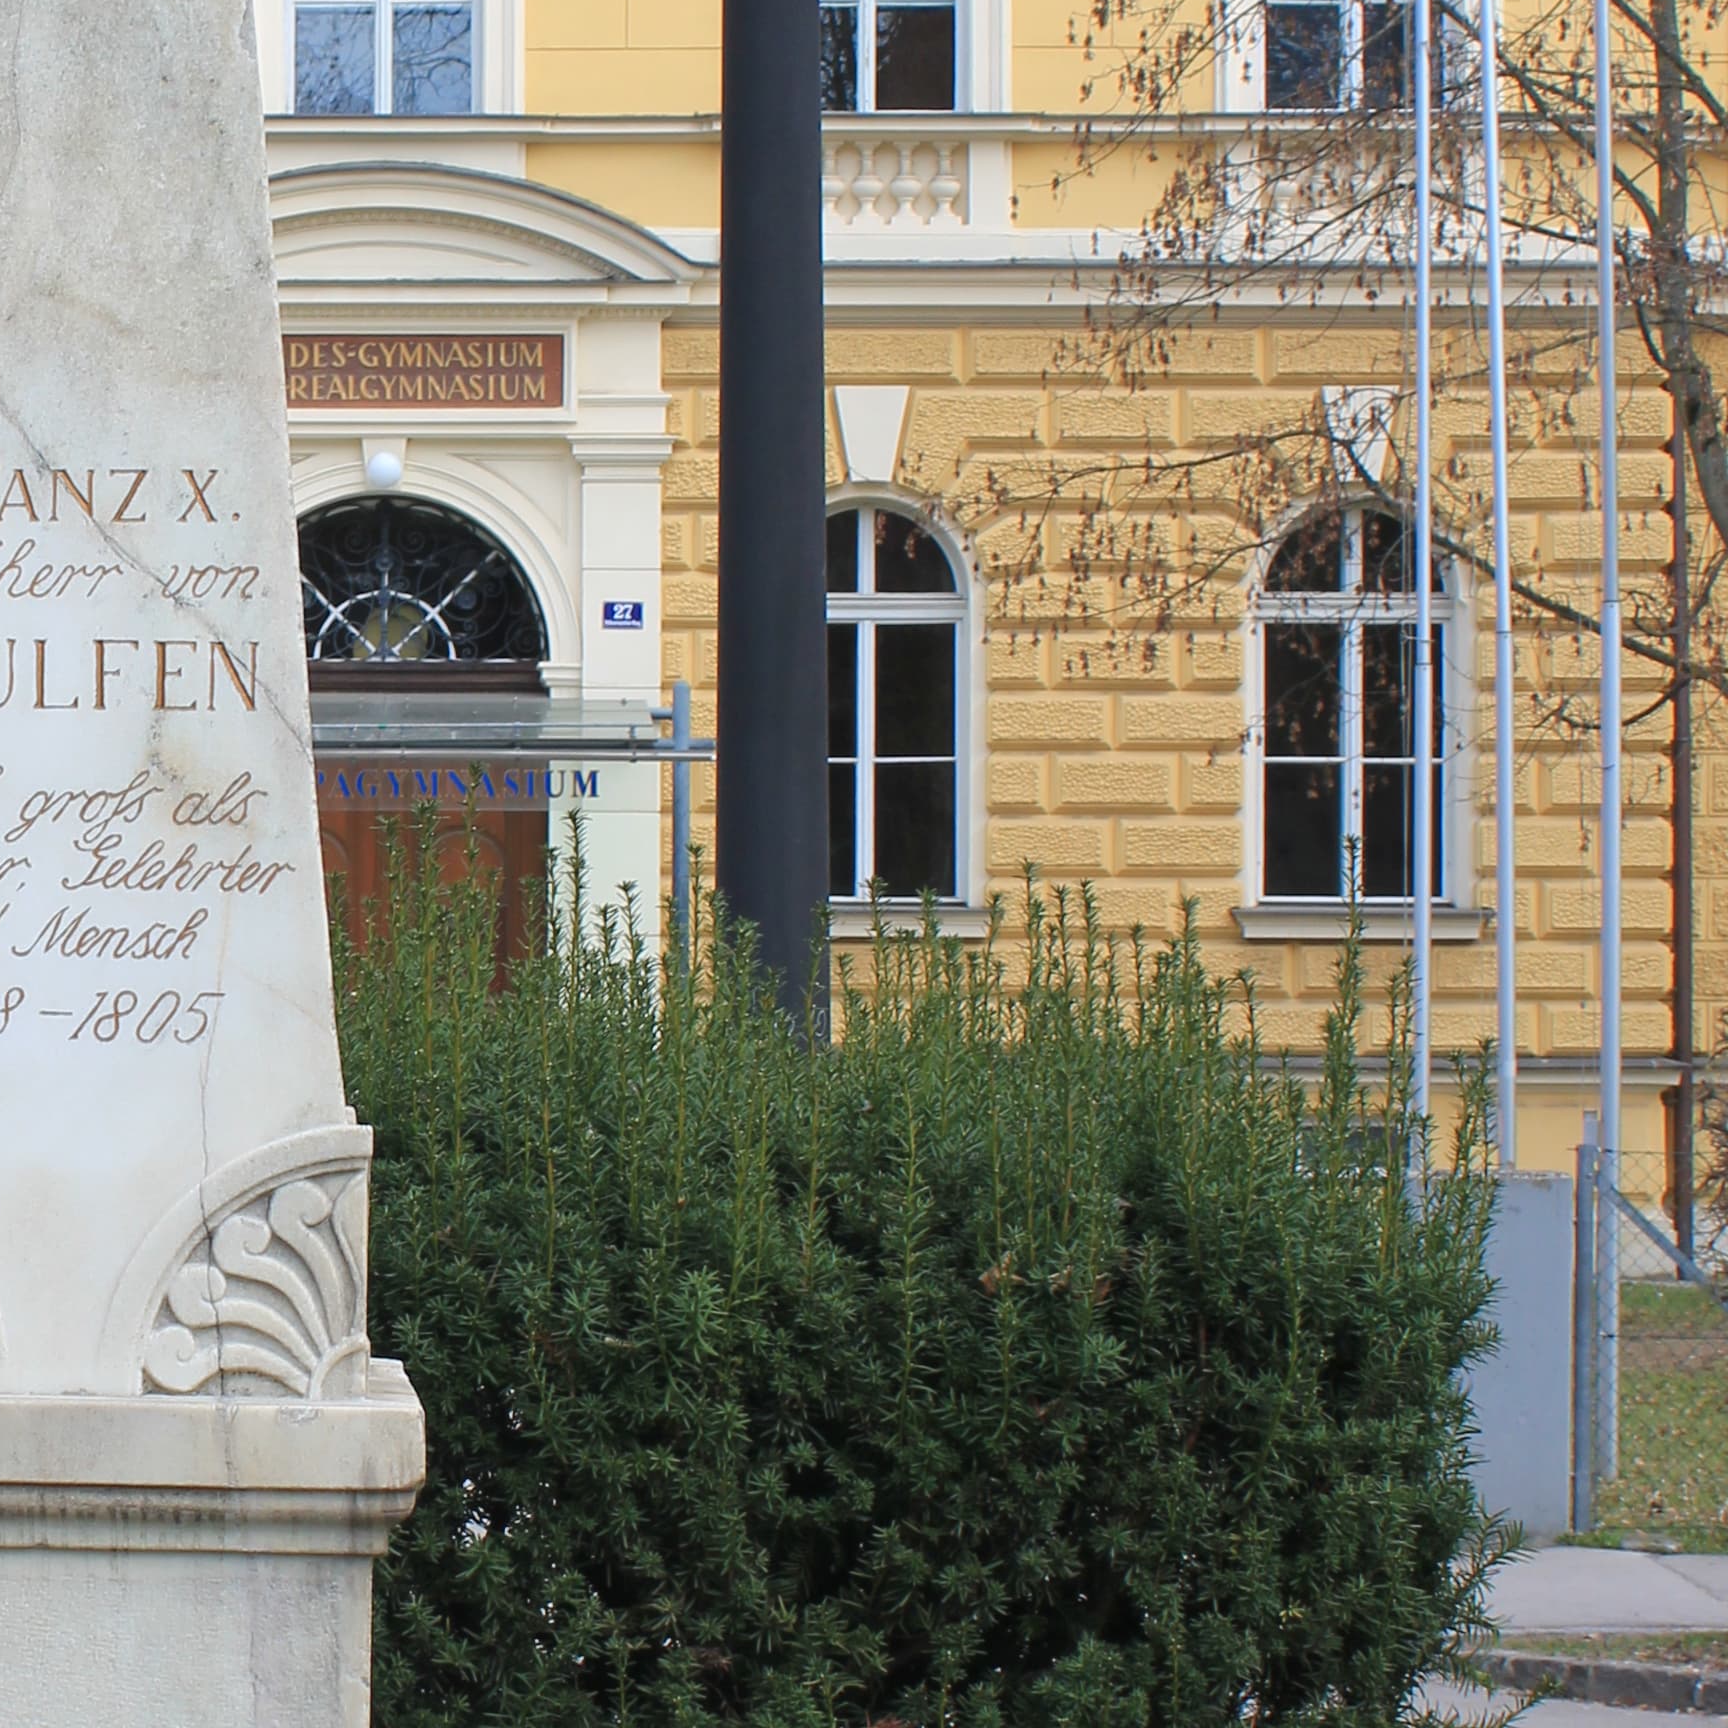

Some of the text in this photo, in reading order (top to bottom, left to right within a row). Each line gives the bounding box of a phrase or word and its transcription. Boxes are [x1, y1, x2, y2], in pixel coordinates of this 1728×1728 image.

[176, 469, 242, 523] X.
[160, 564, 261, 600] von
[613, 603, 633, 620] 27
[171, 770, 269, 827] als
[62, 833, 297, 894] Gelehrter
[10, 905, 209, 960] Mensch
